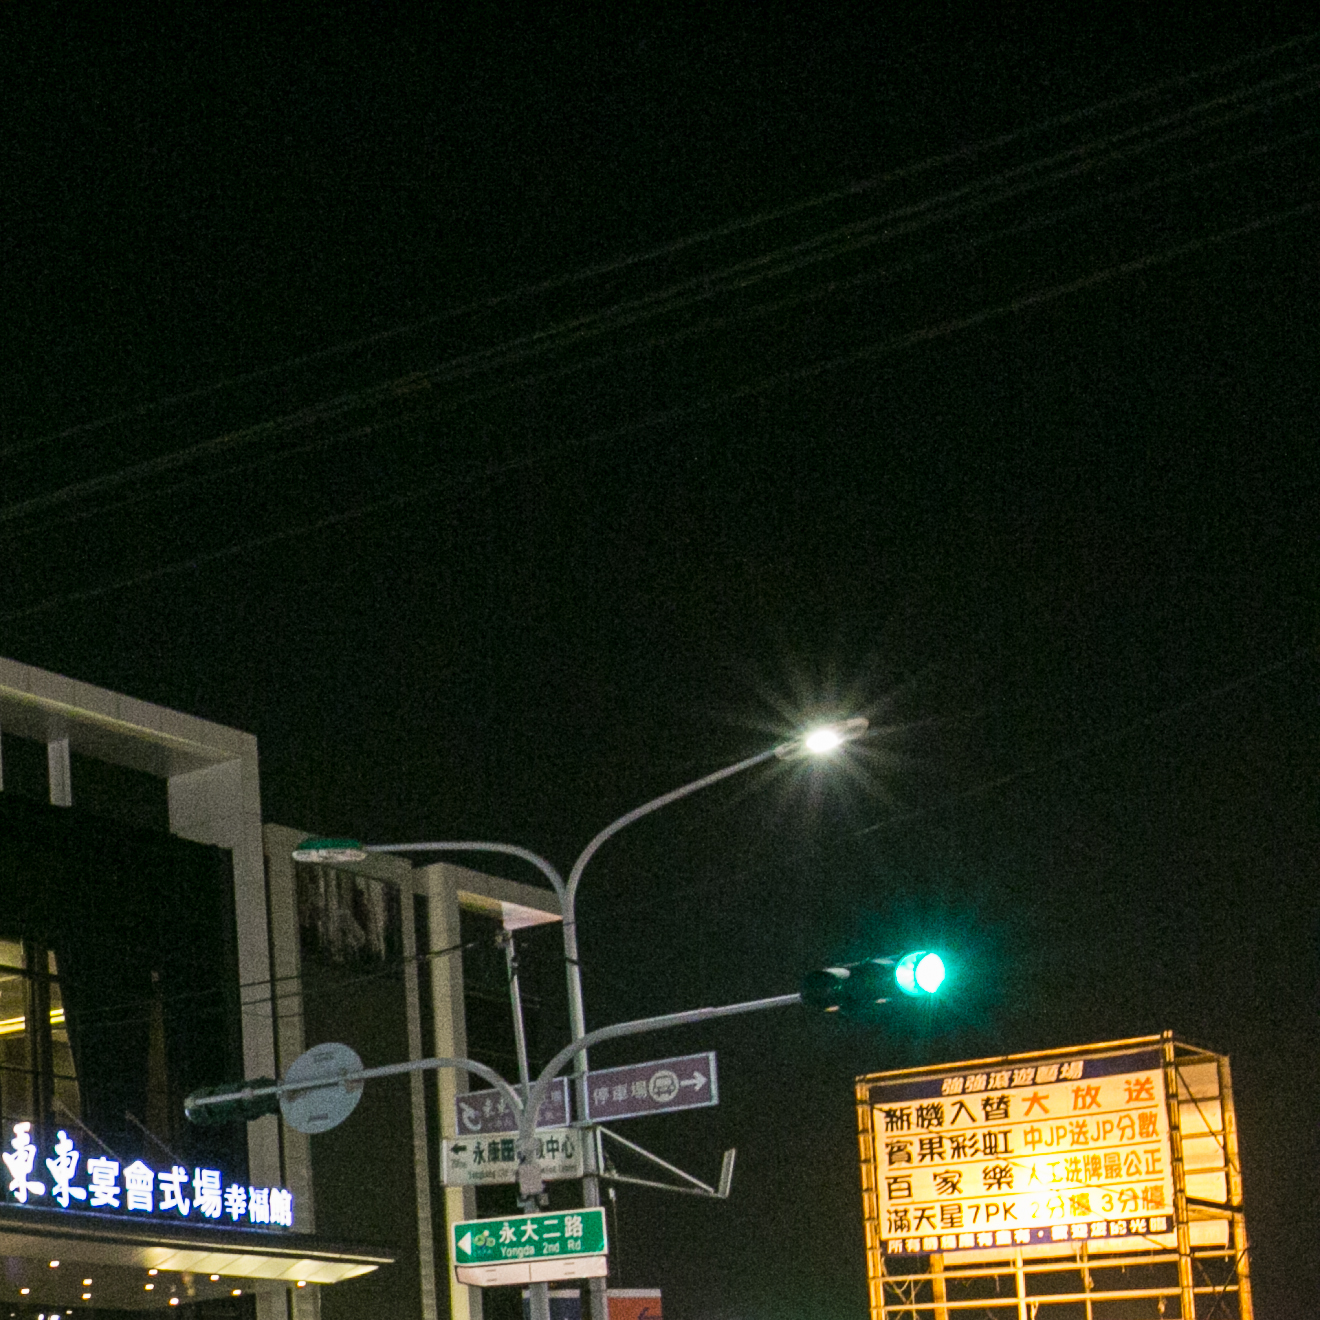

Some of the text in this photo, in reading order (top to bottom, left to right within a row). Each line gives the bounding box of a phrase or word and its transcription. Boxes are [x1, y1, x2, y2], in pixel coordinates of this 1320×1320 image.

[498, 1215, 583, 1244] 永大二路
[500, 1244, 535, 1258] Yongda
[542, 1242, 560, 1254] 2nd
